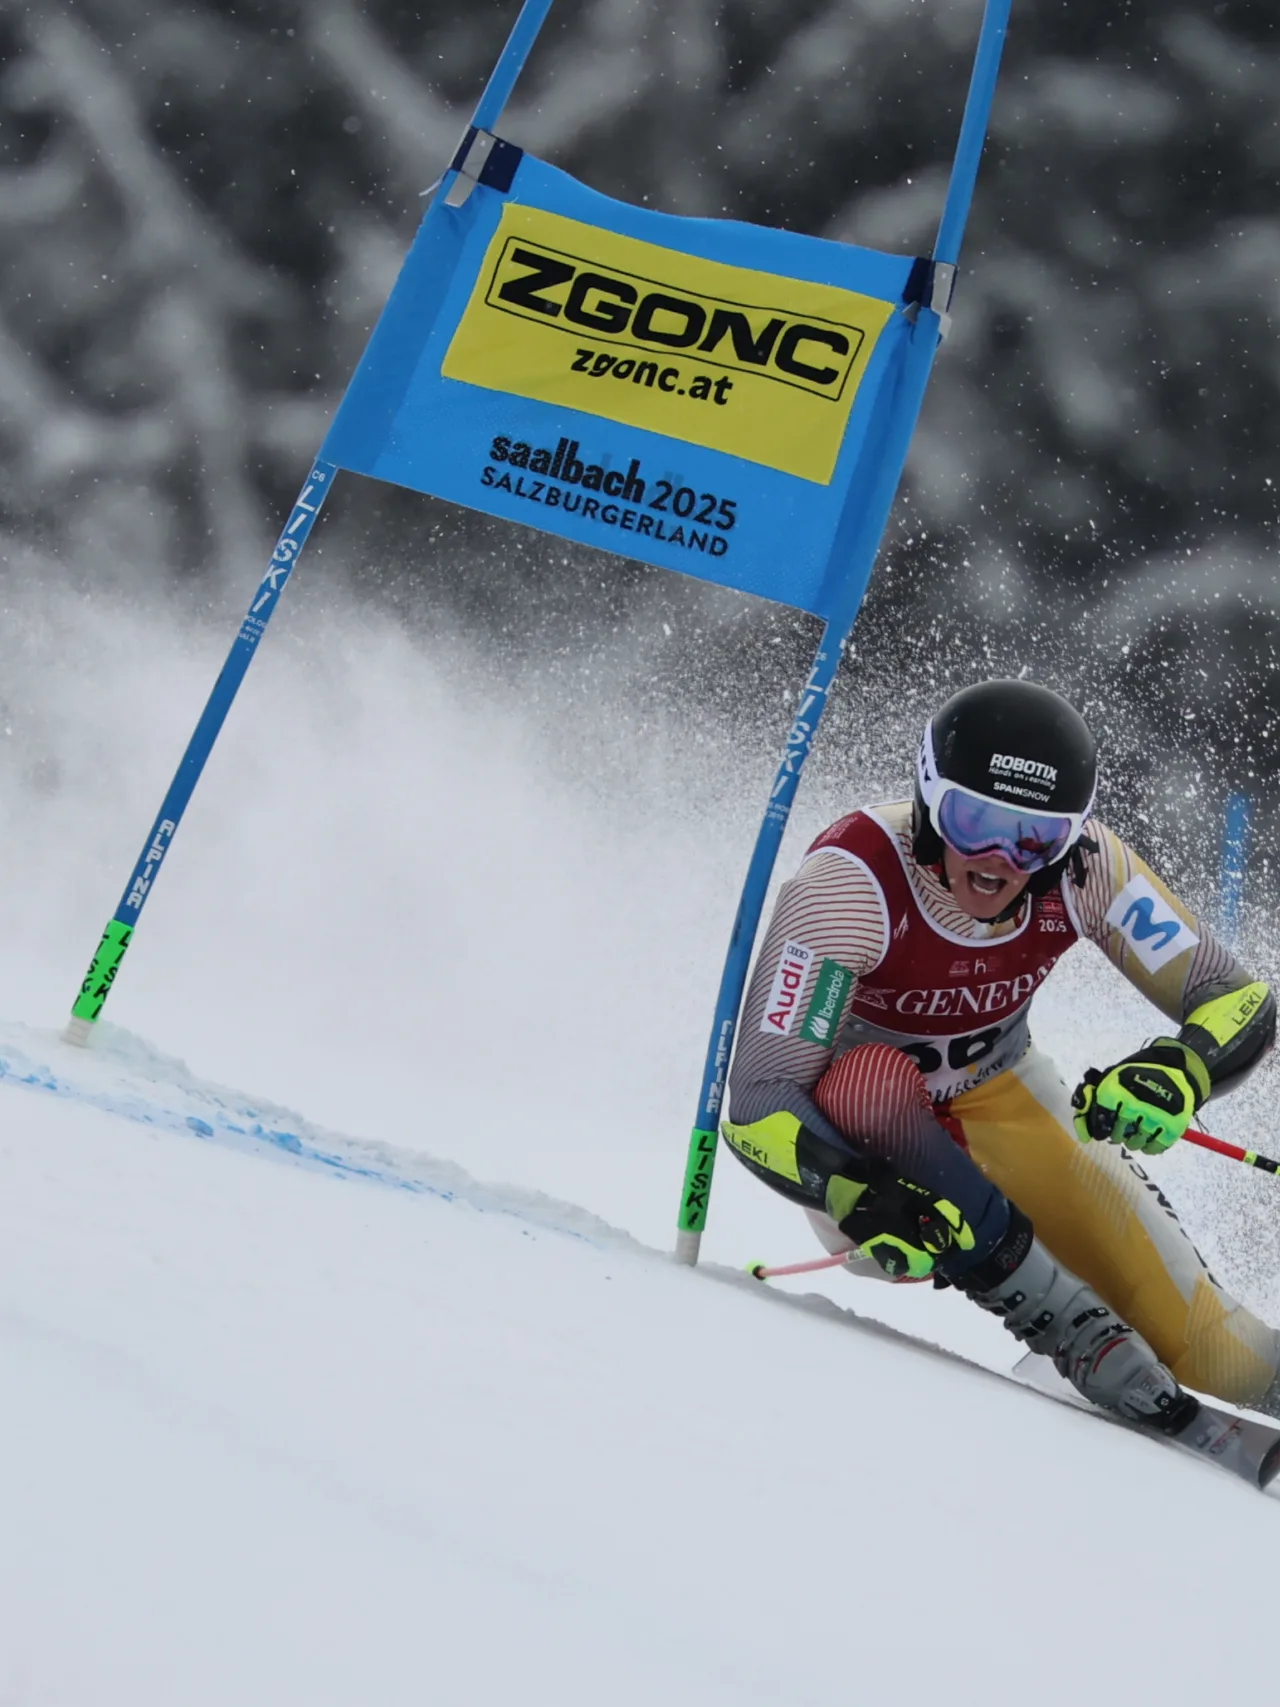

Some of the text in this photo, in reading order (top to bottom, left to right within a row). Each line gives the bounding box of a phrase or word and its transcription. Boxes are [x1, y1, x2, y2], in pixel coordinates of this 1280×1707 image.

[498, 248, 850, 385] ZGONC
[571, 348, 734, 405] zgonc.at
[480, 466, 729, 556] SALZBURGERLAND
[490, 436, 737, 530] saalbach 2025
[252, 485, 316, 613] LISKI
[772, 666, 824, 798] LISKI
[990, 753, 1058, 781] ROBOTIX
[993, 782, 1050, 802] SPAINSNOW
[126, 819, 176, 909] ALPINA
[767, 959, 804, 1031] Audi
[818, 970, 845, 1019] Iberdrola
[1231, 991, 1262, 1026] LEKI
[686, 1135, 713, 1228] LISKI
[731, 1132, 768, 1164] LEKI
